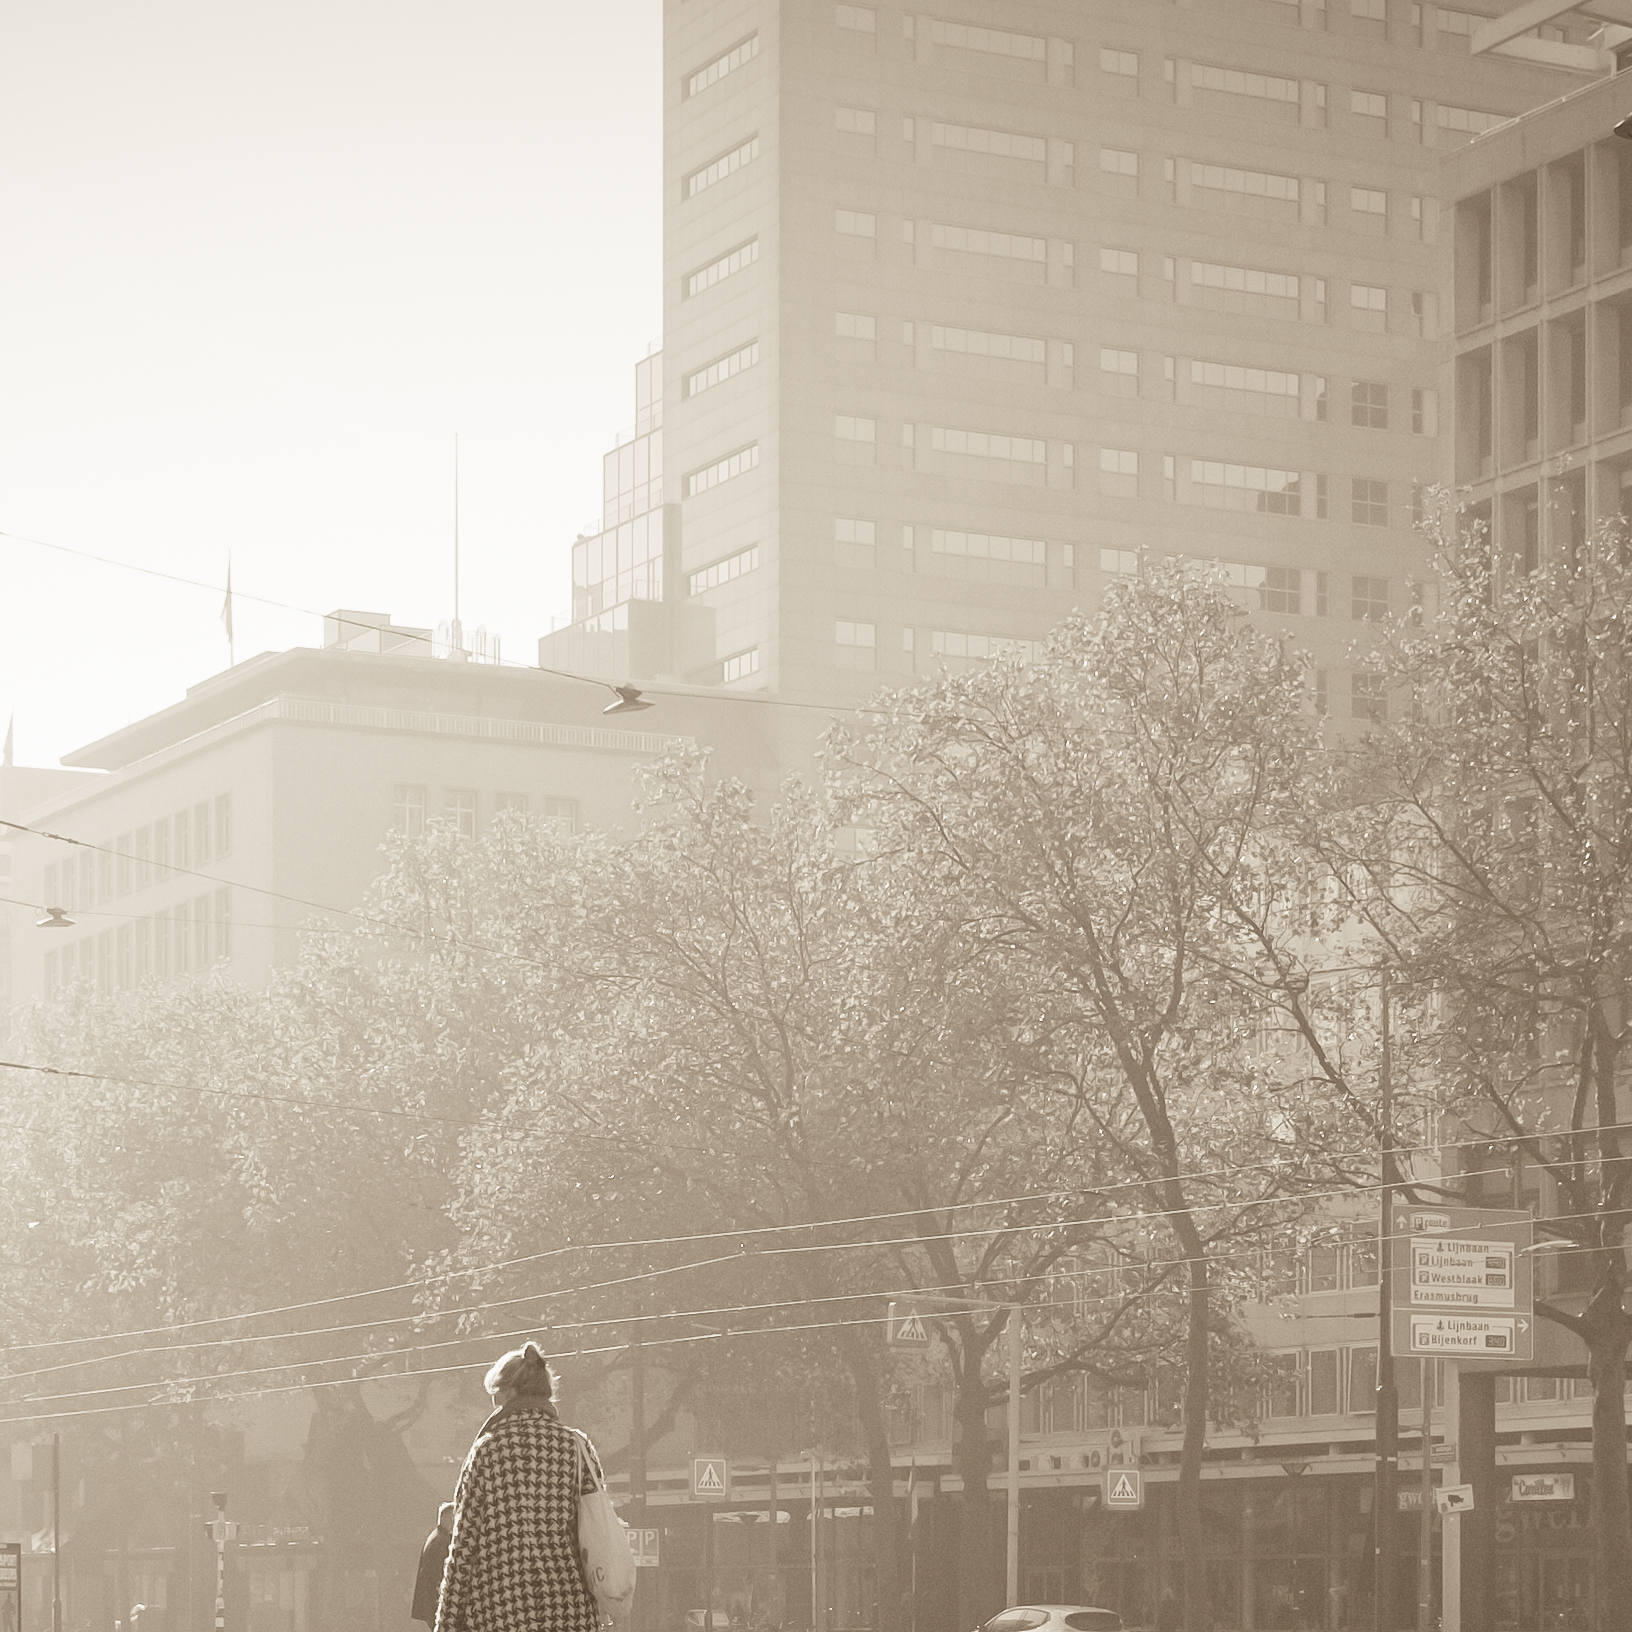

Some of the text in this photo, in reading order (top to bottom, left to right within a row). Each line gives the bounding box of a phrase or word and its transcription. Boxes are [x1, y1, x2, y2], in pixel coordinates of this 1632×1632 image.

[1447, 1242, 1489, 1254] Lijnbaan
[1431, 1256, 1473, 1268] Lijnbaan
[1431, 1273, 1482, 1284] Westblaak
[1414, 1290, 1479, 1303] Erasmusbrug
[1447, 1320, 1489, 1332] Lijnbaan
[1431, 1335, 1477, 1346] Bijenkorf
[645, 1531, 655, 1545] P
